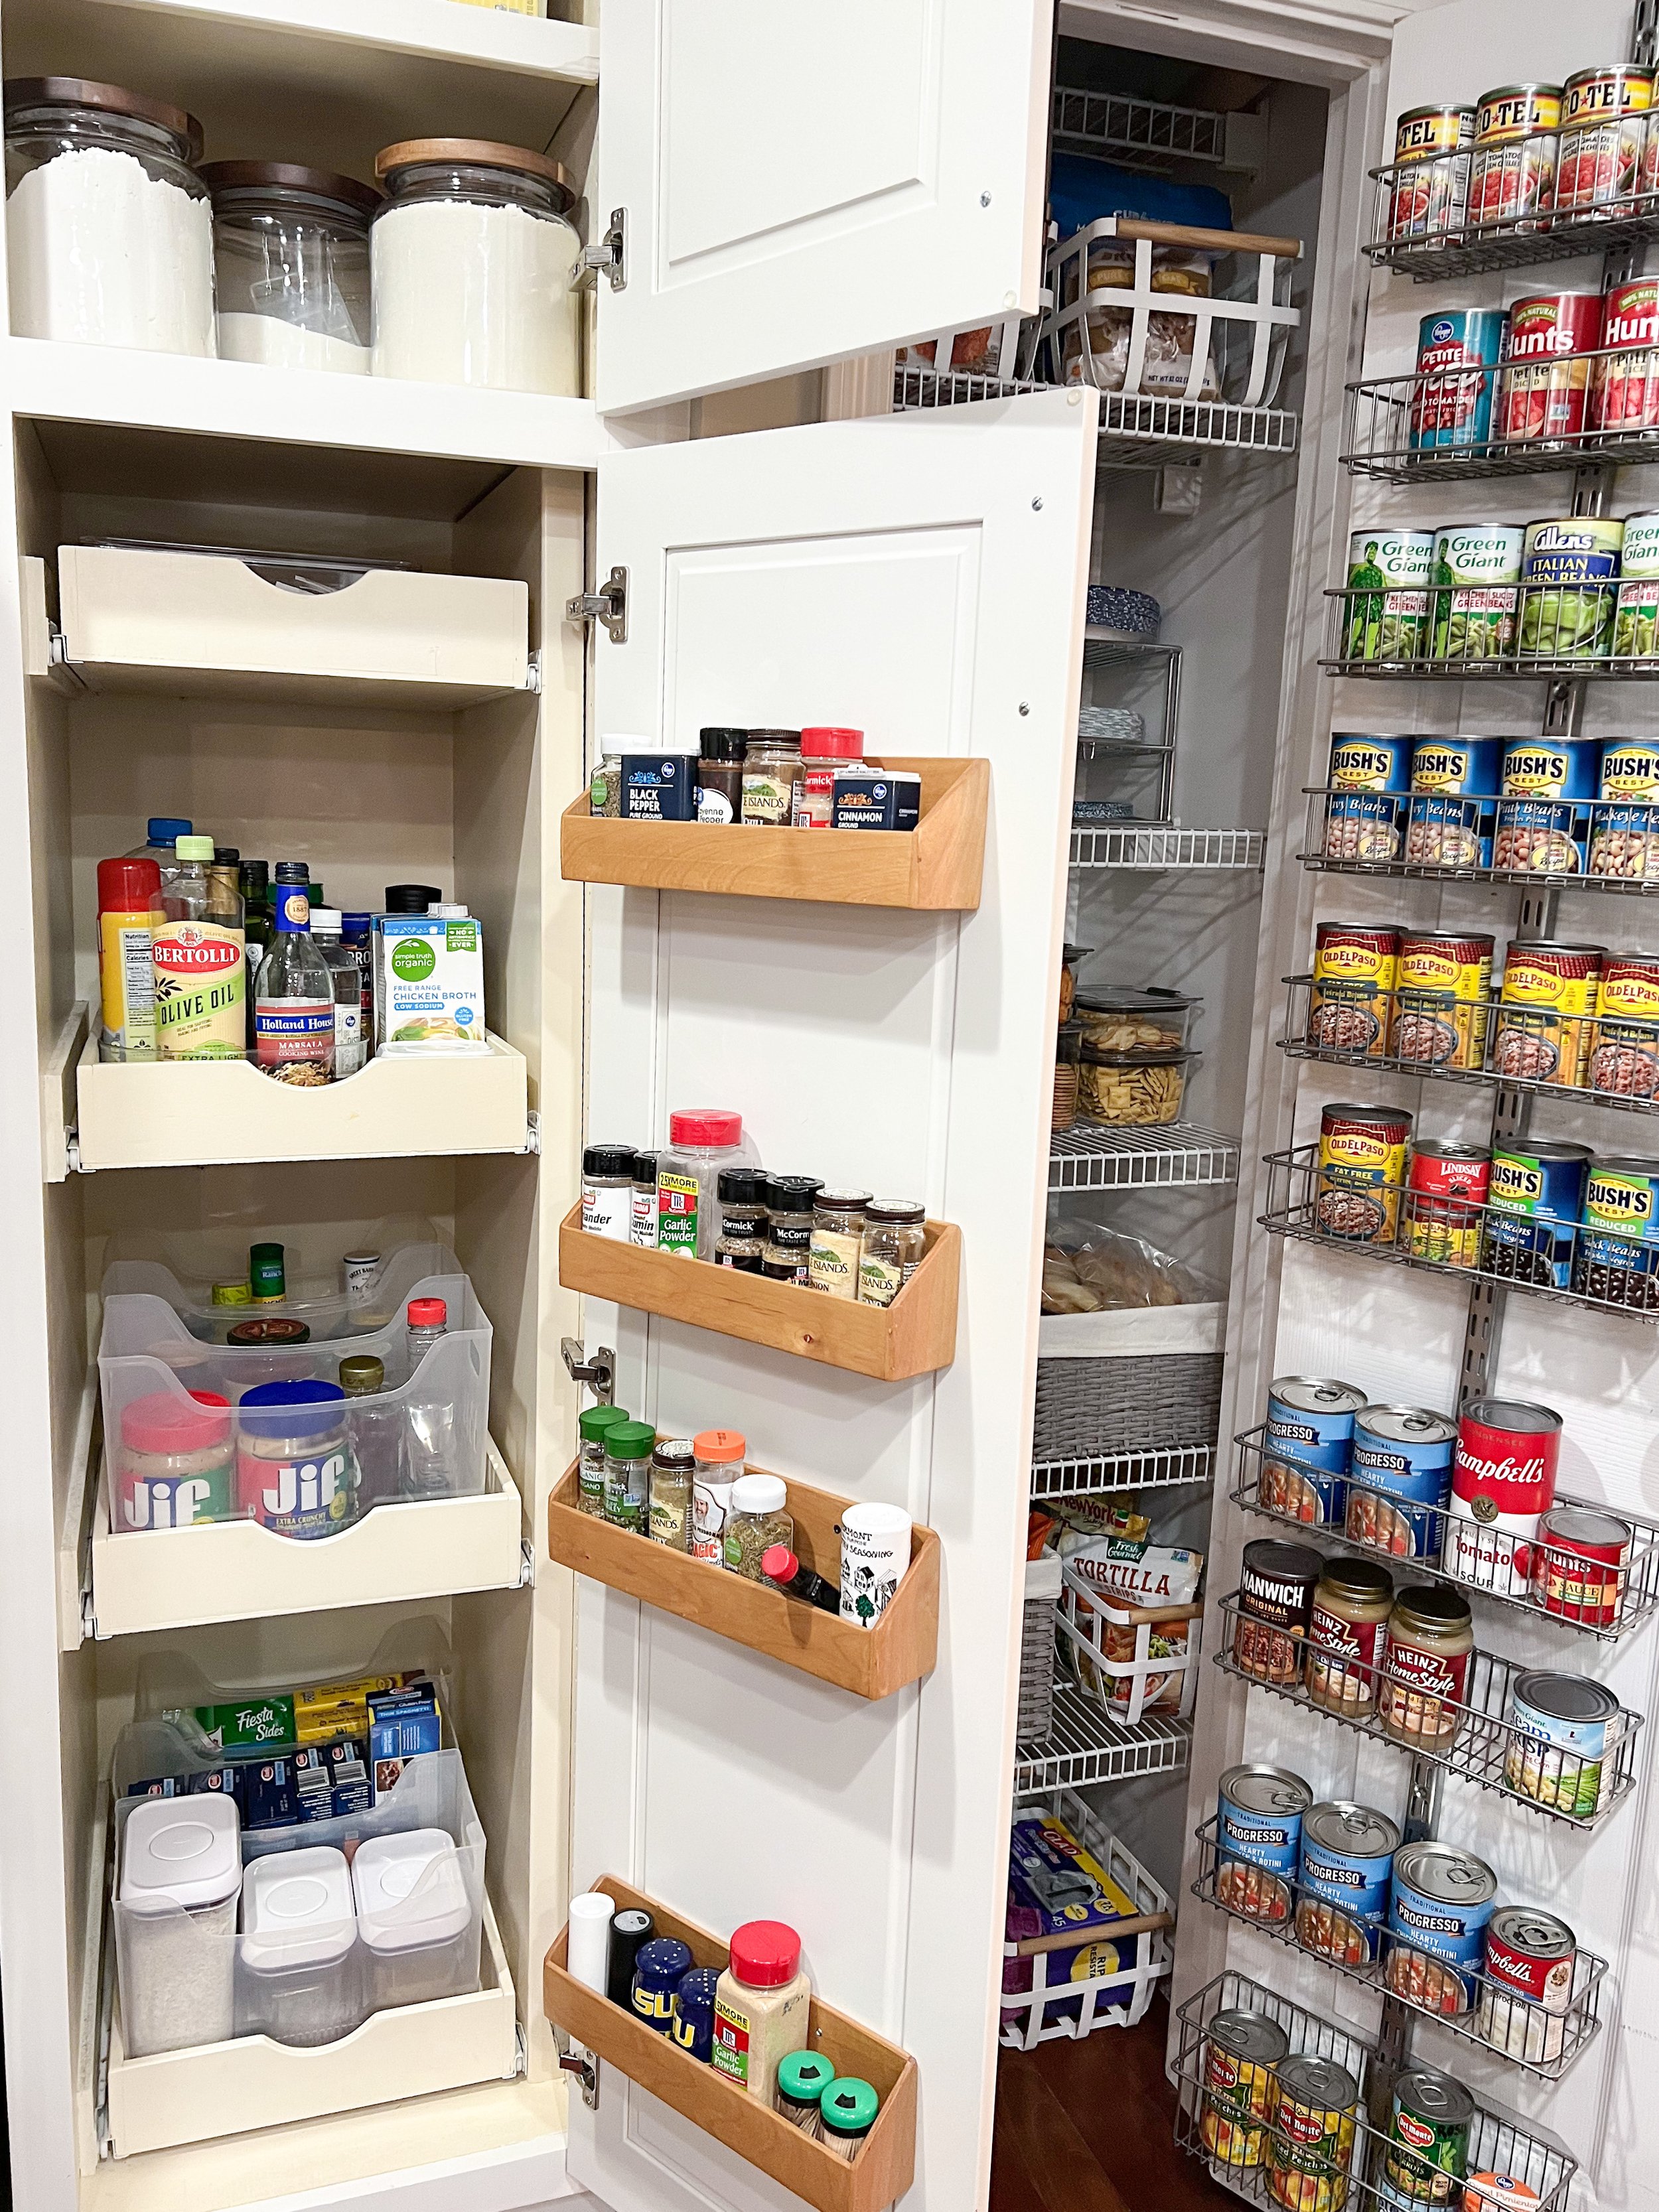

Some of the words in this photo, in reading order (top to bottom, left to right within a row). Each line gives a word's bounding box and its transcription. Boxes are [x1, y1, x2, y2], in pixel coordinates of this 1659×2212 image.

[1422, 348, 1463, 366] PETITE
[1382, 540, 1432, 556] Green
[1451, 535, 1506, 552] Green
[1455, 552, 1508, 569] Giant
[1533, 557, 1588, 572] ITALIAN
[1333, 750, 1388, 773] BUSH'S
[1413, 753, 1464, 776] BUSH'S
[1504, 755, 1563, 778] BUSH'S
[630, 789, 659, 800] BLACK
[749, 797, 784, 808] ISLANDS
[629, 799, 660, 812] PEPPER
[838, 811, 883, 823] CINNAMON
[155, 947, 236, 963] BERTOLLI
[395, 959, 433, 968] organic
[161, 995, 204, 1026] OLIVE
[210, 984, 234, 1009] OIL
[262, 1018, 305, 1030] Holland
[279, 1040, 323, 1050] MARSALA
[1331, 1139, 1346, 1150] OLD
[1334, 1166, 1349, 1175] FAT
[1350, 1170, 1374, 1180] FREE
[1441, 1162, 1482, 1178] LINDSAY
[671, 1177, 697, 1189] MORE
[1449, 1175, 1473, 1185] SLICED
[1496, 1184, 1518, 1195] BEST
[1588, 1181, 1648, 1213] BUSH'S
[1598, 1206, 1626, 1216] BEST
[664, 1219, 692, 1231] Garlic
[1590, 1215, 1636, 1233] REDUCED
[660, 1230, 696, 1242] Powder
[262, 1270, 283, 1279] Ranch
[813, 1261, 848, 1274] ISLANDS
[262, 1454, 344, 1515] Jif
[1361, 1468, 1386, 1484] HEARTY
[124, 1479, 210, 1528] Jif
[297, 1512, 326, 1524] CRUNCHY
[1084, 1499, 1116, 1526] York
[849, 1545, 894, 1558] SEASONING
[1108, 1546, 1142, 1560] Gourmet
[1116, 1540, 1139, 1553] Fresh
[1456, 1535, 1510, 1566] Tomato
[1073, 1557, 1171, 1596] TORTILLA
[1105, 1585, 1139, 1602] STRIPS
[1242, 1566, 1305, 1609] MANWICH
[1559, 1582, 1599, 1596] SAUCE
[1246, 1594, 1288, 1616] ORIGINAL
[1313, 1610, 1343, 1635] HEINZ
[1398, 1650, 1439, 1673] HEINZ
[236, 1706, 273, 1732] Fiesta
[255, 1724, 285, 1742] Sides
[1238, 1812, 1271, 1827] TRADITIONAL
[1227, 1823, 1283, 1842] PROGRESSO
[1043, 1830, 1078, 1855] GLAD
[1239, 1843, 1266, 1858] HEARTY
[1305, 1856, 1360, 1885] PROGRESSO
[1315, 1881, 1342, 1898] HEARTY
[1409, 1895, 1447, 1915] TRADITIONAL
[1052, 1915, 1066, 1927] 45
[1398, 1904, 1459, 1932] PROGRESSO
[1411, 1929, 1439, 1947] HEARTY
[1098, 1955, 1106, 1976] RIP
[723, 2004, 749, 2026] MORE
[717, 2046, 740, 2065] Garlic
[715, 2055, 743, 2076] Powder
[1399, 2116, 1409, 2132] Del
[1408, 2124, 1432, 2142] Monte
